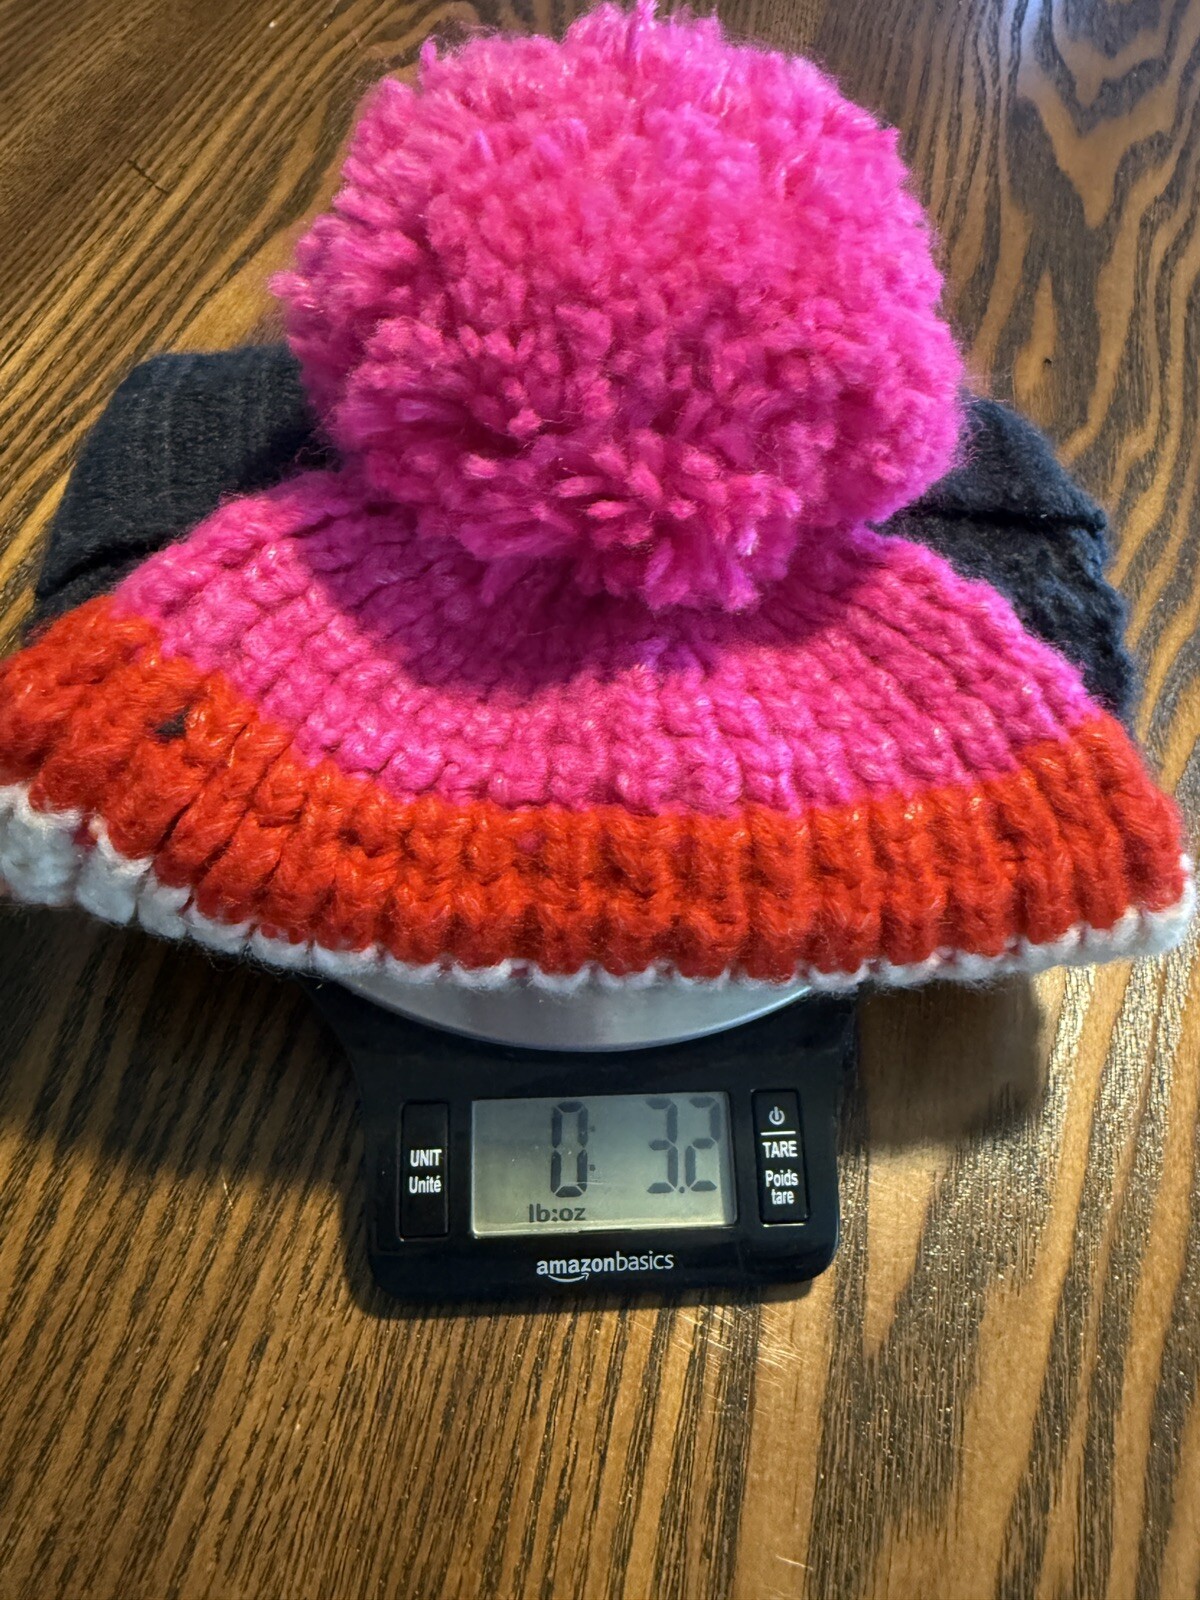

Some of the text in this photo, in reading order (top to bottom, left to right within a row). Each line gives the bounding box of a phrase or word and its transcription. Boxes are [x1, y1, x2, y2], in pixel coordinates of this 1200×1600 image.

[646, 1096, 721, 1194] 3.2
[762, 1140, 798, 1158] TARE
[410, 1149, 442, 1167] UNIT
[409, 1176, 442, 1194] Unité
[765, 1169, 799, 1187] Poids
[771, 1189, 795, 1205] tare
[528, 1203, 586, 1223] lb:oz
[536, 1251, 674, 1275] amazonbasics
